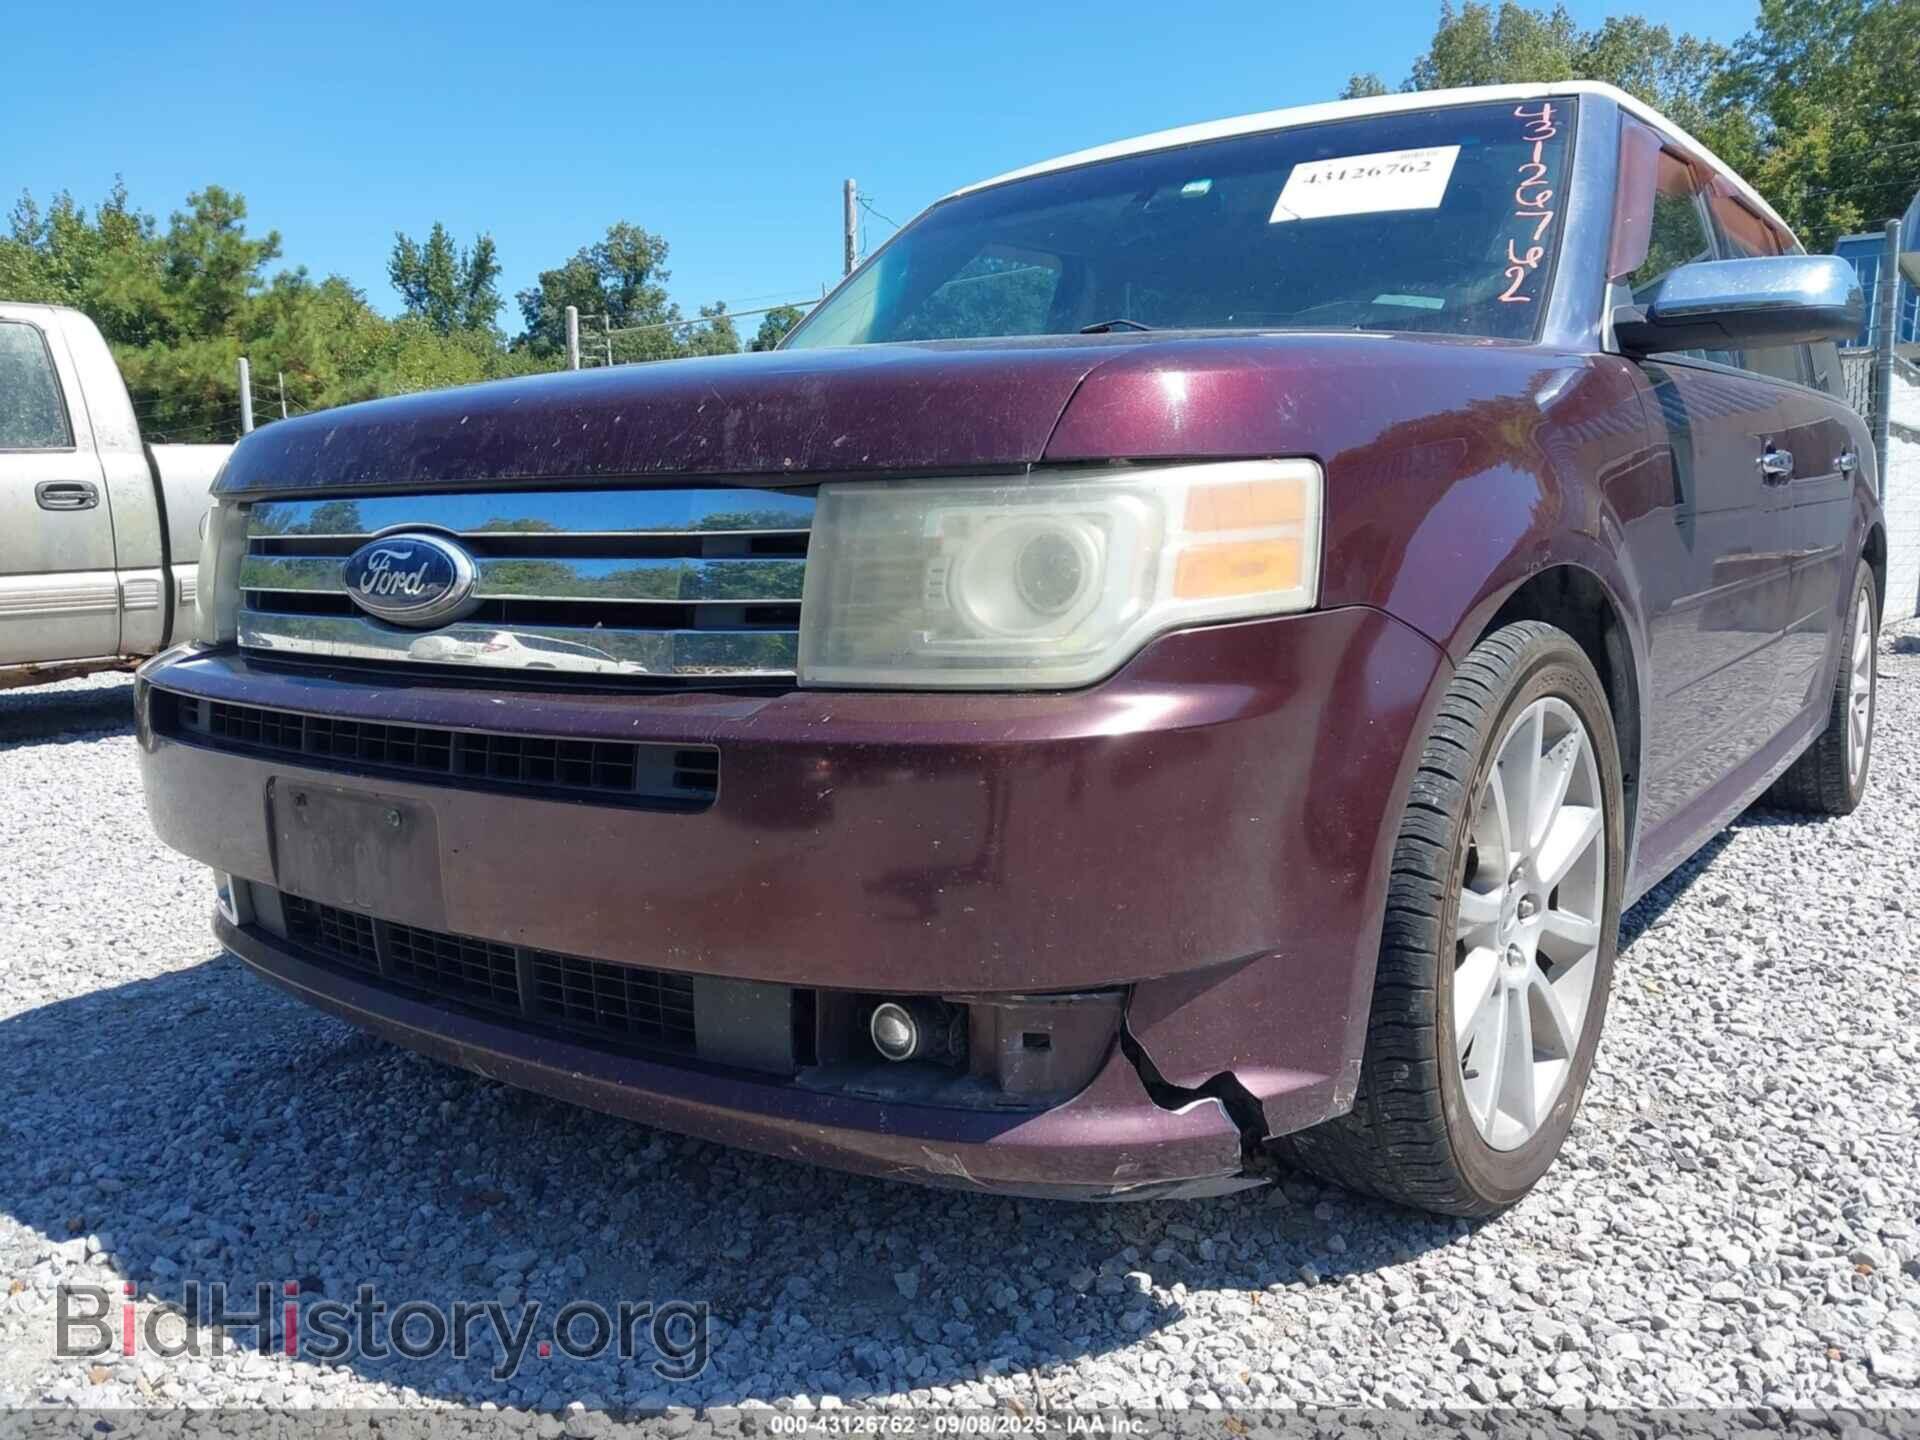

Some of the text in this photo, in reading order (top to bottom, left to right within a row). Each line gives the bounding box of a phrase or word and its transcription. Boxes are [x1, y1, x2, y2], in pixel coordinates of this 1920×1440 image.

[1303, 161, 1432, 184] 43126762
[1498, 103, 1557, 302] 43126762
[359, 549, 429, 595] Ford
